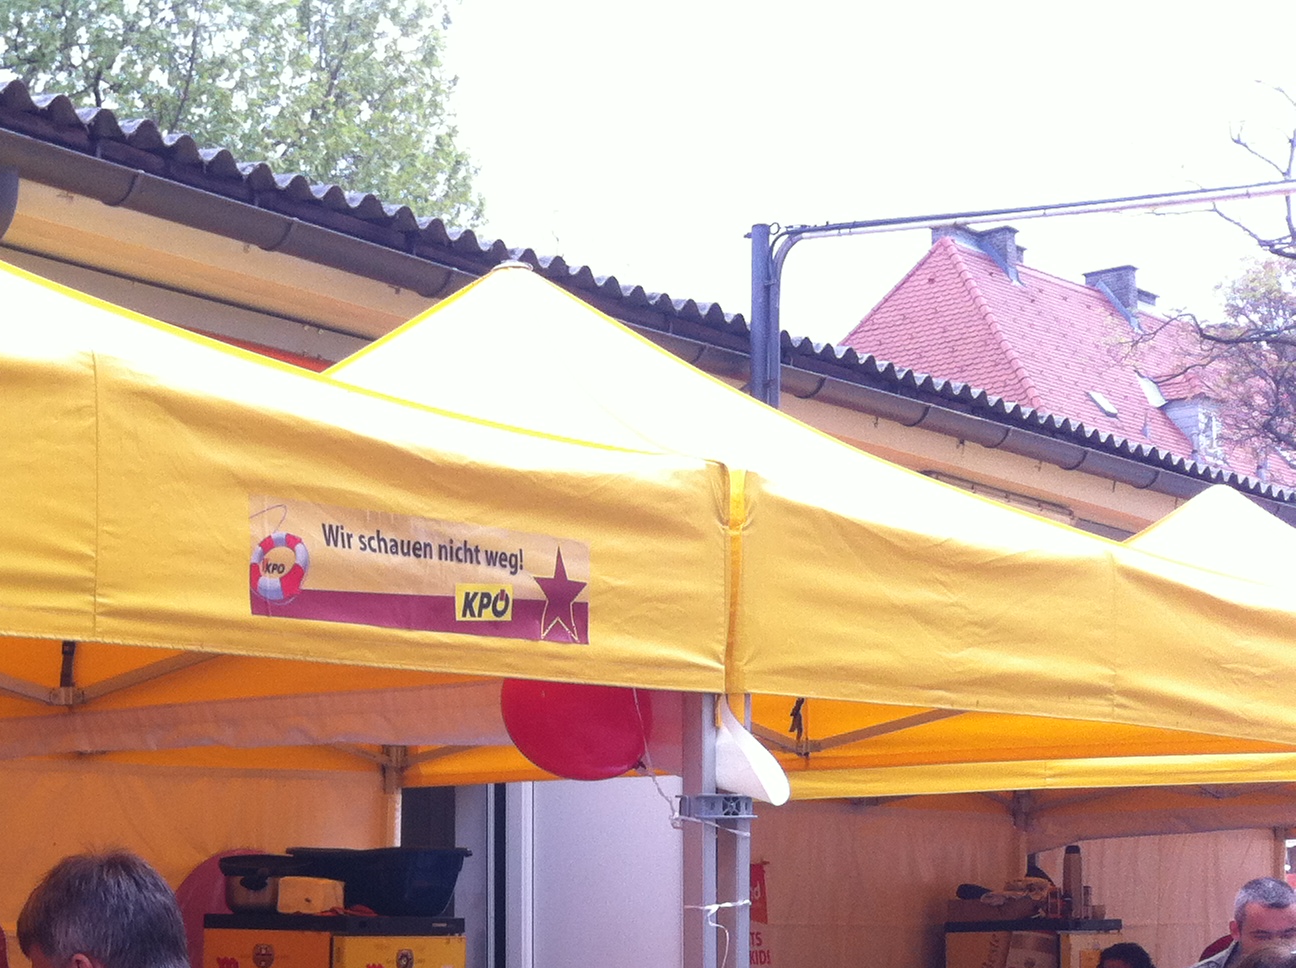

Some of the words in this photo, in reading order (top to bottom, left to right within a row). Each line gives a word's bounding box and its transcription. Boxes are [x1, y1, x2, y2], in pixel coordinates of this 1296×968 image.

[321, 522, 353, 551] Wir
[358, 529, 433, 560] schauen
[437, 540, 481, 566] nicht
[484, 548, 524, 576] weg!
[461, 587, 510, 619] KPÖ
